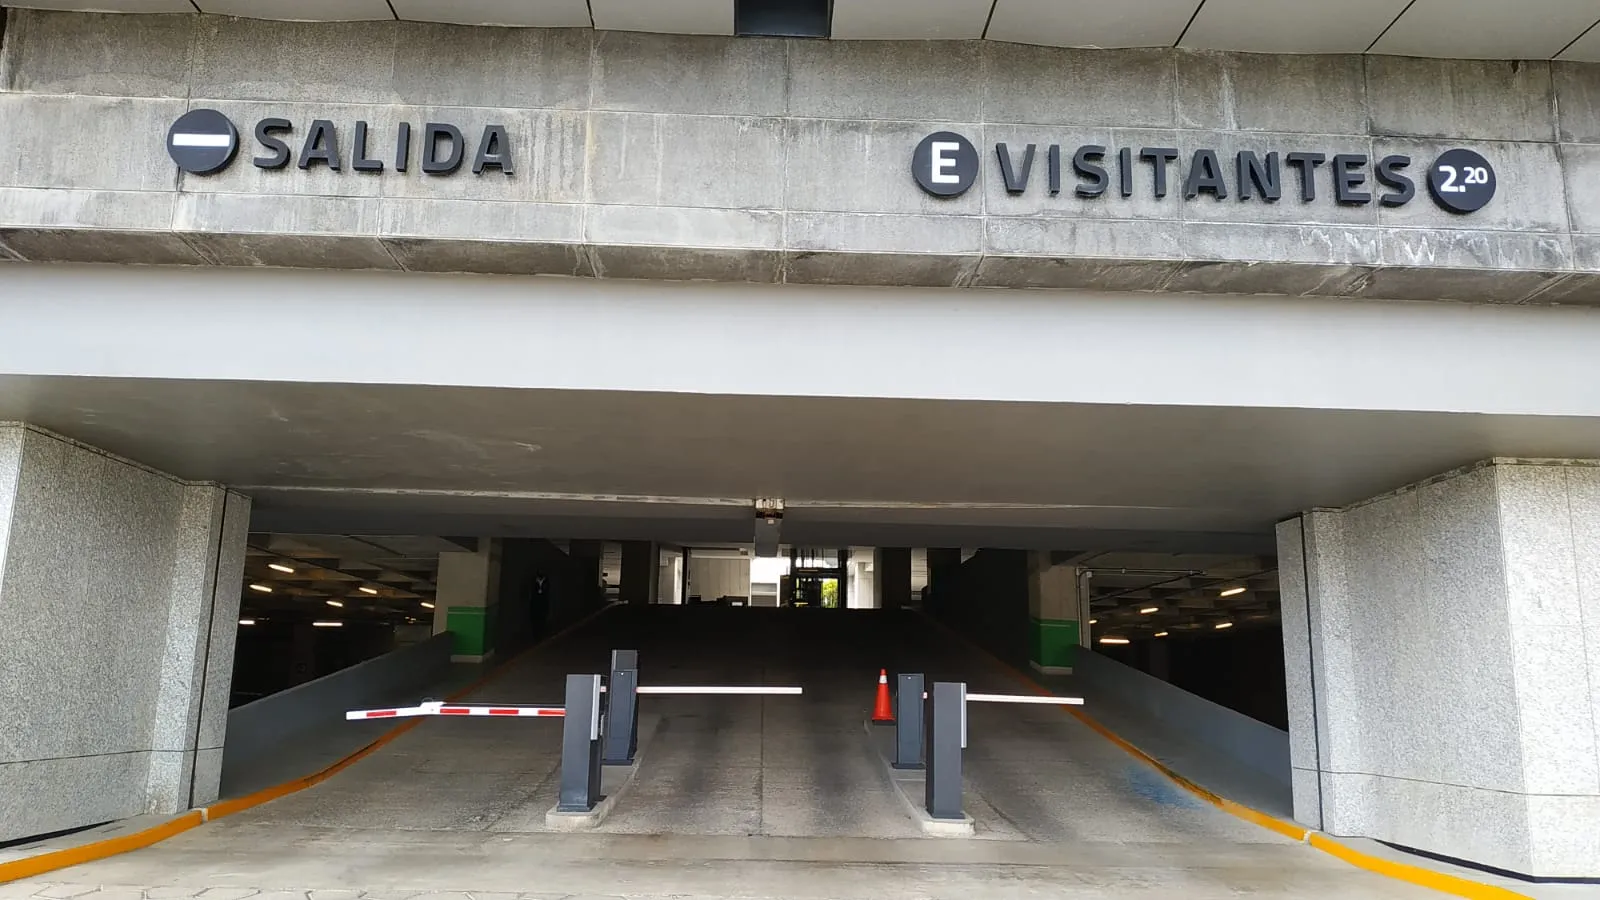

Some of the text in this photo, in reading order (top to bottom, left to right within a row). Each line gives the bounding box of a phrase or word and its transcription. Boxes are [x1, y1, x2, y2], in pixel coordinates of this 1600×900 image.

[253, 117, 514, 175] SALIDA
[931, 141, 1489, 206] E VISITANTES 2.20
